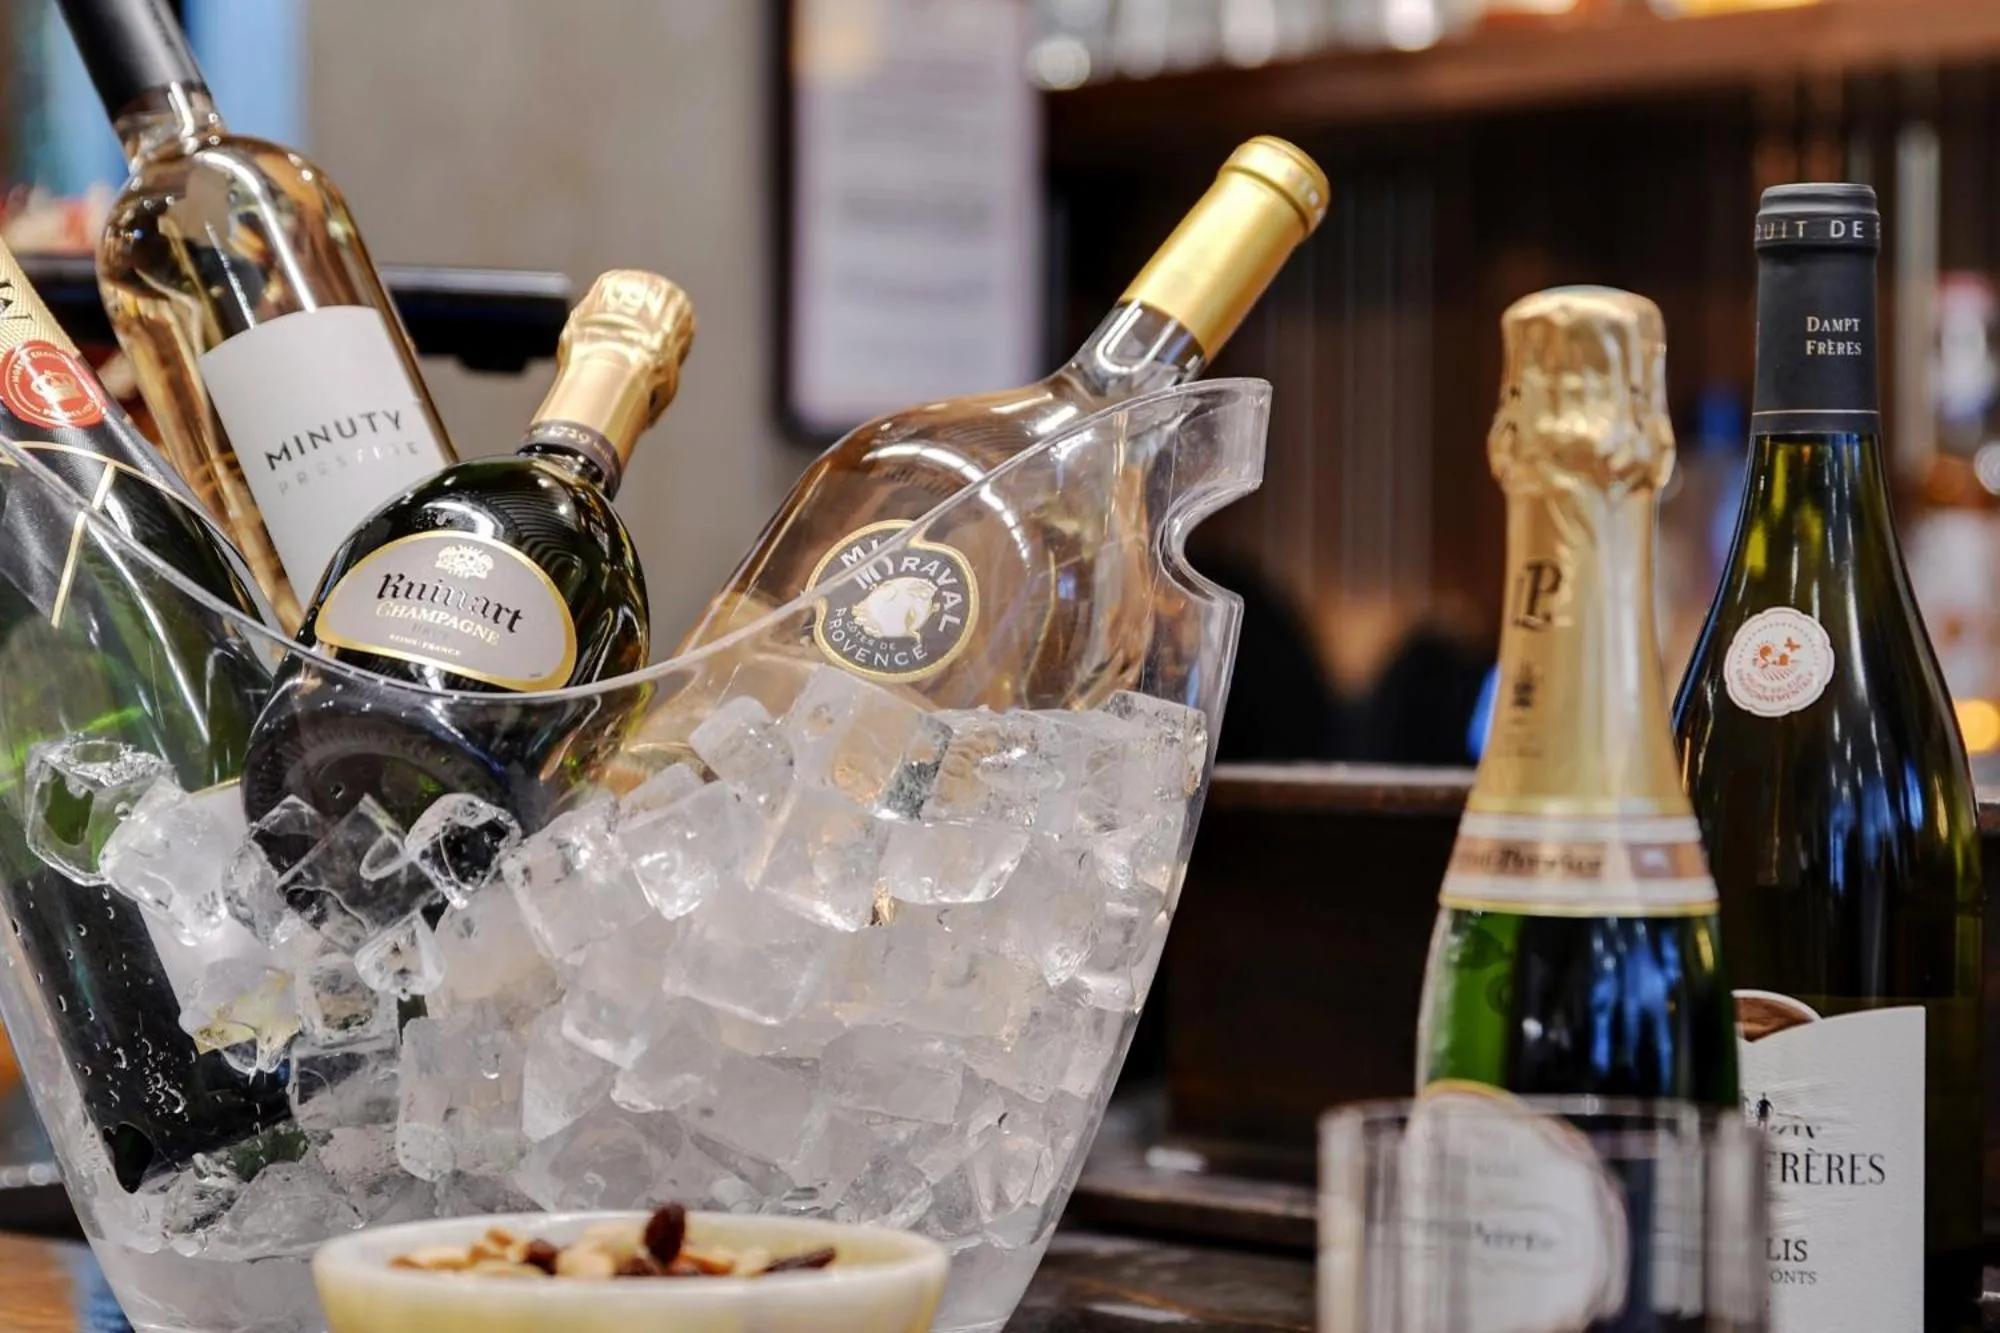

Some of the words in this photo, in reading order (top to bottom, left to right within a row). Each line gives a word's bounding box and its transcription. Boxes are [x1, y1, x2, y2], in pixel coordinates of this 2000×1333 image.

[1830, 219, 1864, 238] DE
[264, 409, 401, 471] MINUTY
[376, 572, 523, 634] Ruinart
[376, 601, 500, 646] CHAMPAGNE
[829, 607, 928, 667] PROVENCE
